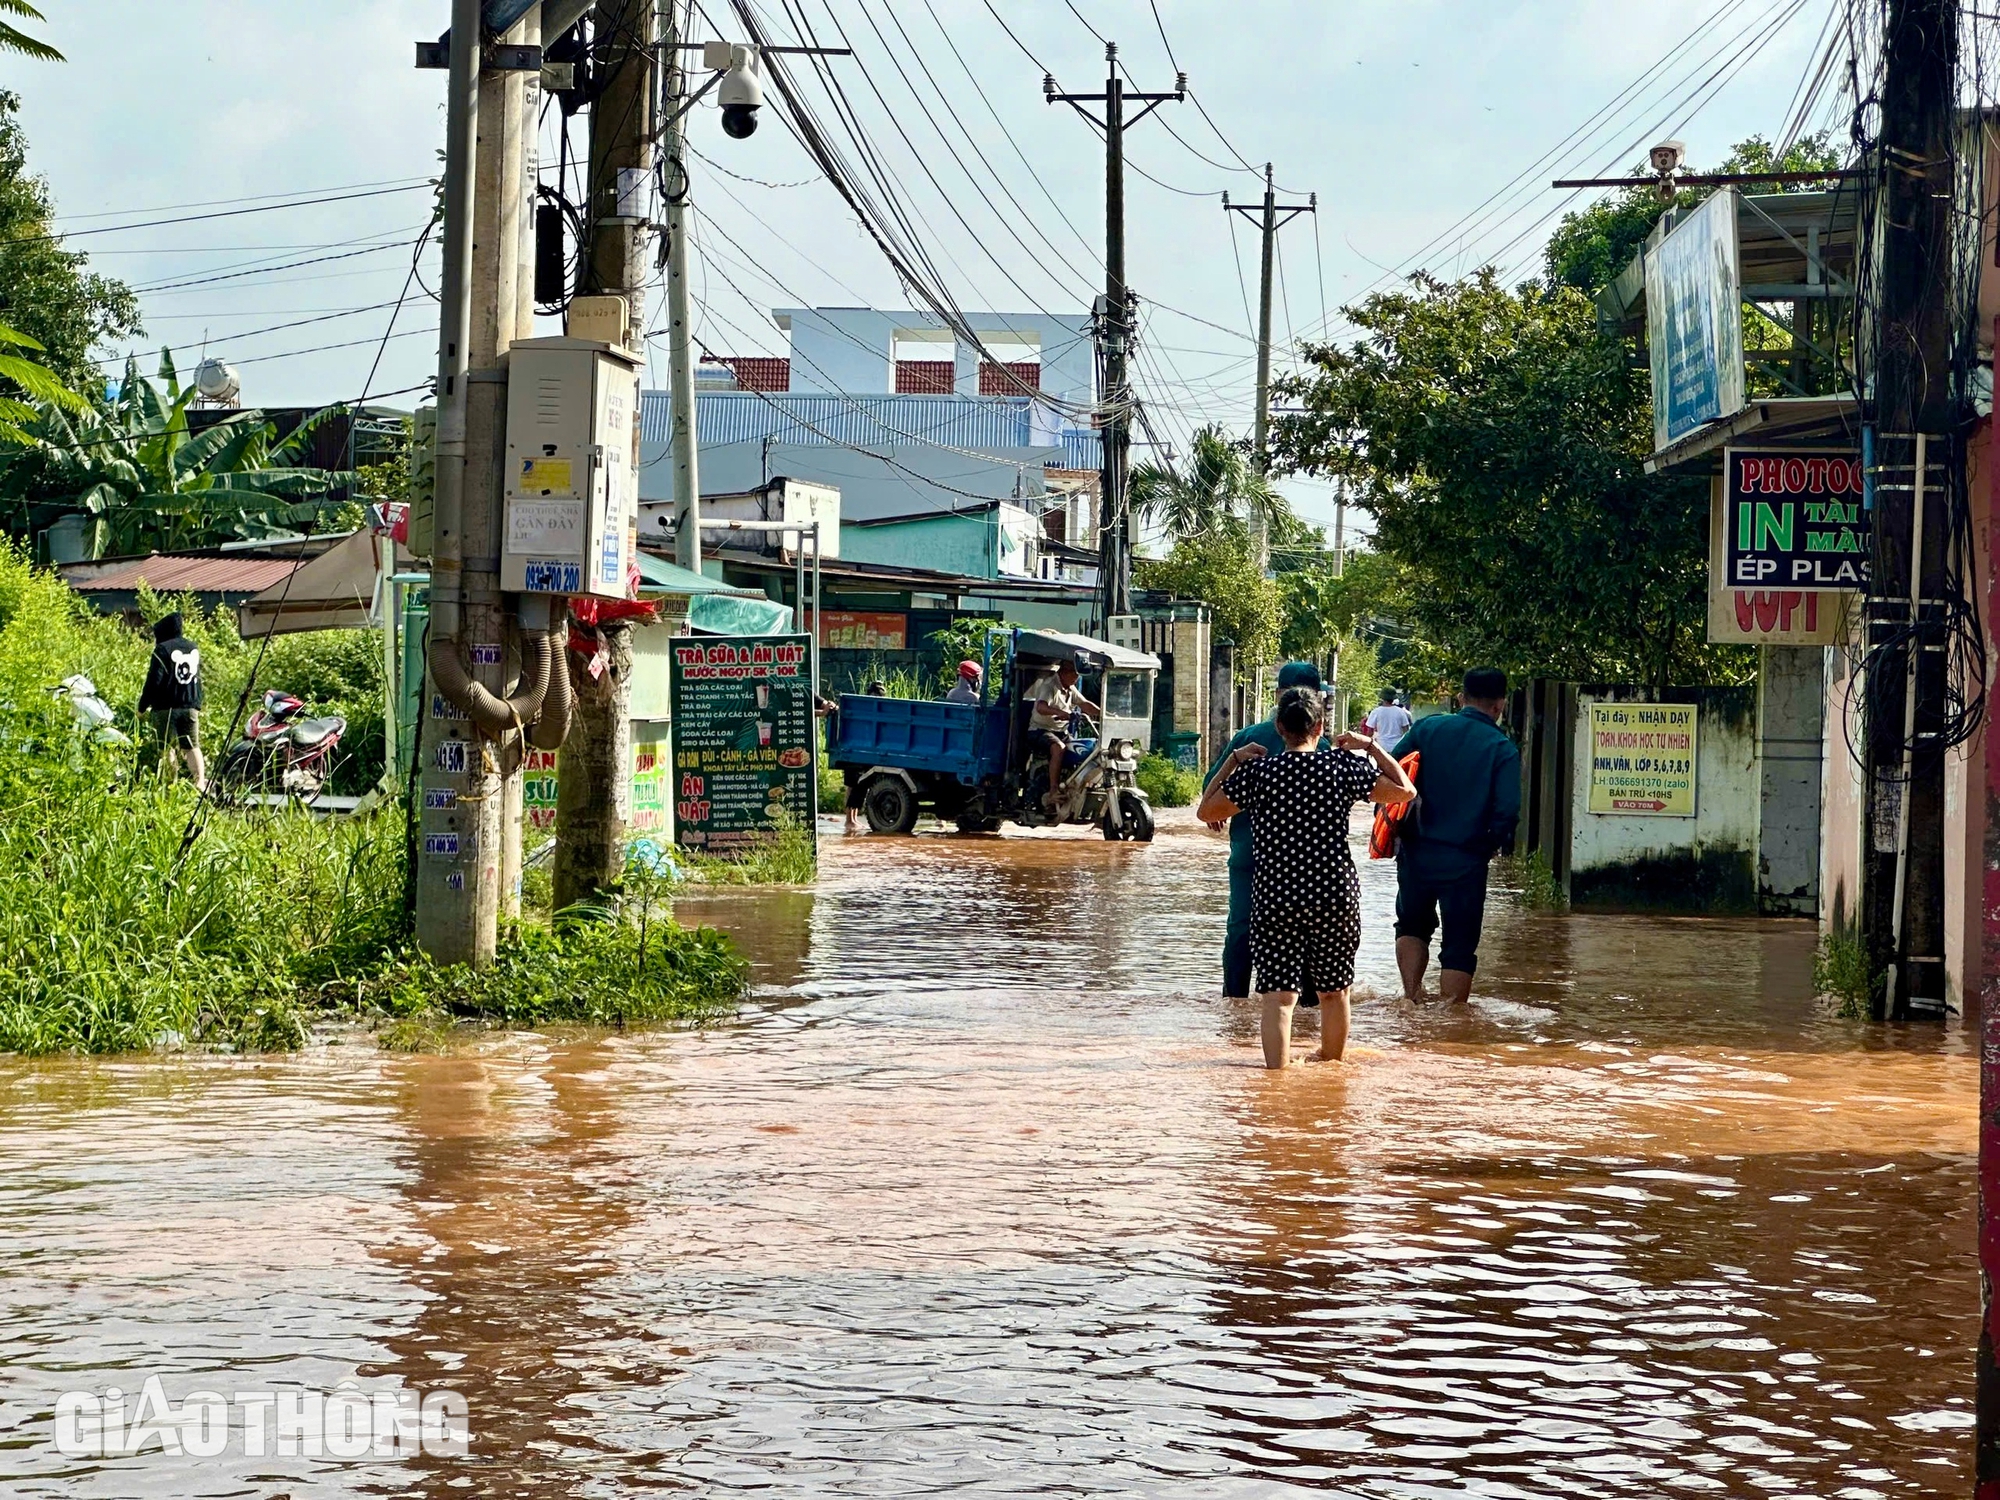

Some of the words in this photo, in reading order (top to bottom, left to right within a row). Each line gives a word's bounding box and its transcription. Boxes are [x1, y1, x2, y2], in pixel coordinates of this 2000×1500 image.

[1803, 498, 1859, 523] TÀI
[548, 516, 576, 530] ĐÂY
[1738, 502, 1794, 552] IN
[1736, 554, 1778, 581] ÉP
[676, 643, 705, 664] TRÀ
[707, 644, 737, 664] SỮA
[739, 647, 750, 663] &
[753, 643, 773, 663] ĂN
[683, 664, 717, 678] NƯỚC
[718, 665, 751, 680] NGỌT
[752, 665, 768, 677] 5K
[776, 665, 799, 676] 10K
[710, 683, 724, 691] CÁC
[1595, 710, 1609, 726] Tại
[1639, 708, 1667, 728] NHẬN
[1670, 712, 1690, 728] DẠY
[701, 729, 716, 737] CÁC
[703, 764, 723, 772] KHOAI
[1635, 754, 1651, 771] LỚP
[682, 772, 704, 796] ĂN
[1664, 778, 1689, 790] (zalo)
[1609, 788, 1626, 798] BÁN
[1629, 788, 1645, 798] TRÚ
[678, 797, 711, 825] VẶT
